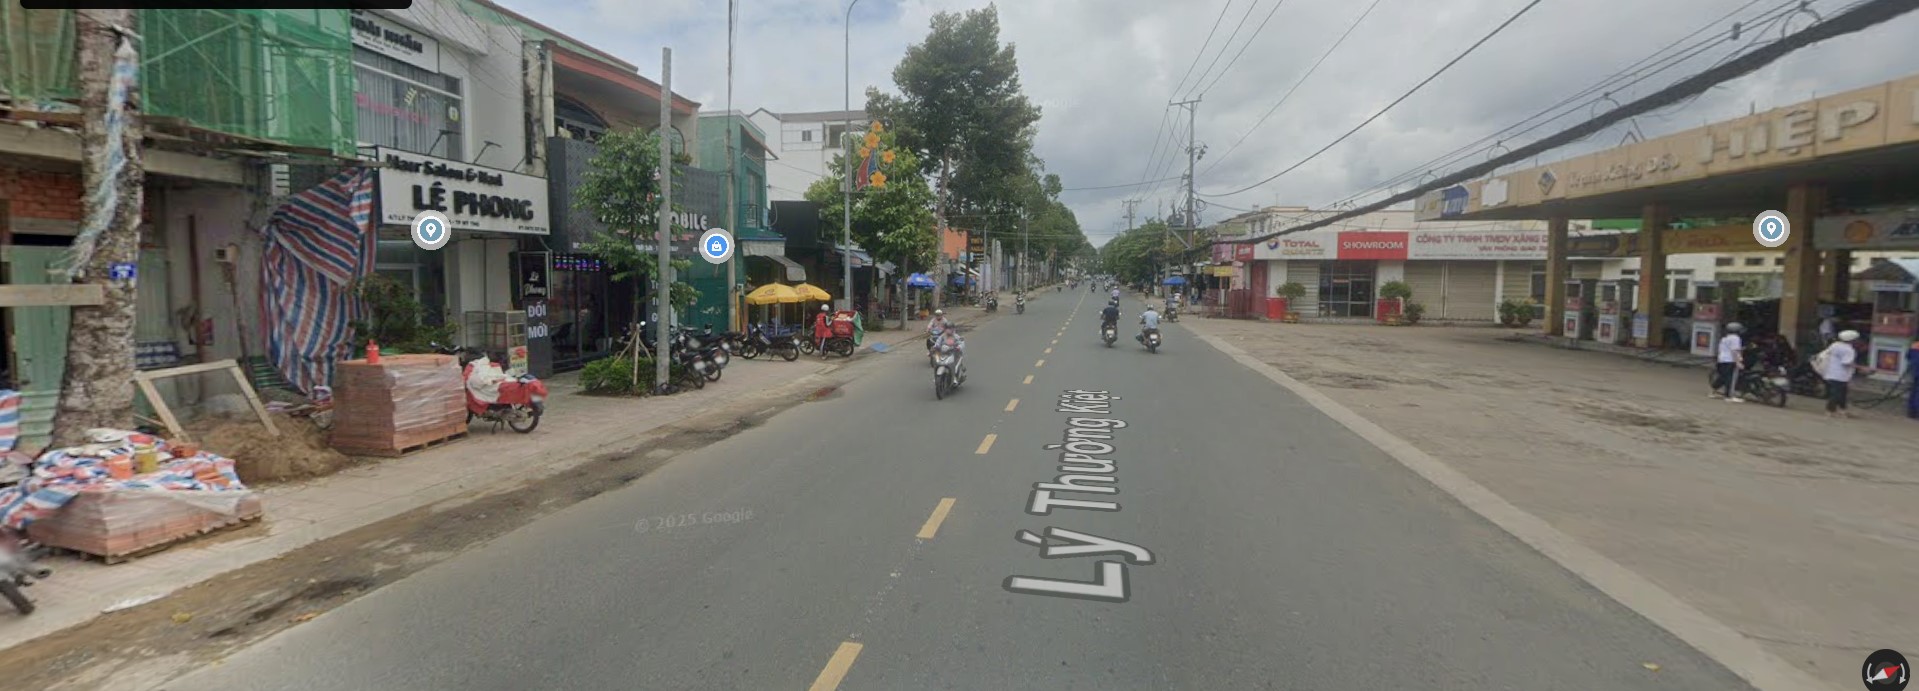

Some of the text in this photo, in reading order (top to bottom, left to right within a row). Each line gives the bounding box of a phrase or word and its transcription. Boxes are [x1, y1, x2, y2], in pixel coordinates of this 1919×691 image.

[1698, 101, 1880, 164] HIỆP
[423, 161, 463, 180] Salon
[466, 168, 478, 182] &
[412, 181, 534, 221] LÊ PHONG
[1282, 239, 1320, 248] TOTAL
[1343, 241, 1404, 250] SHOWROOM
[1416, 233, 1442, 244] CÔNG
[1443, 235, 1456, 243] TY
[1457, 235, 1482, 243] TNHH
[1512, 233, 1539, 243] XĂNG
[528, 322, 548, 339] MỚI
